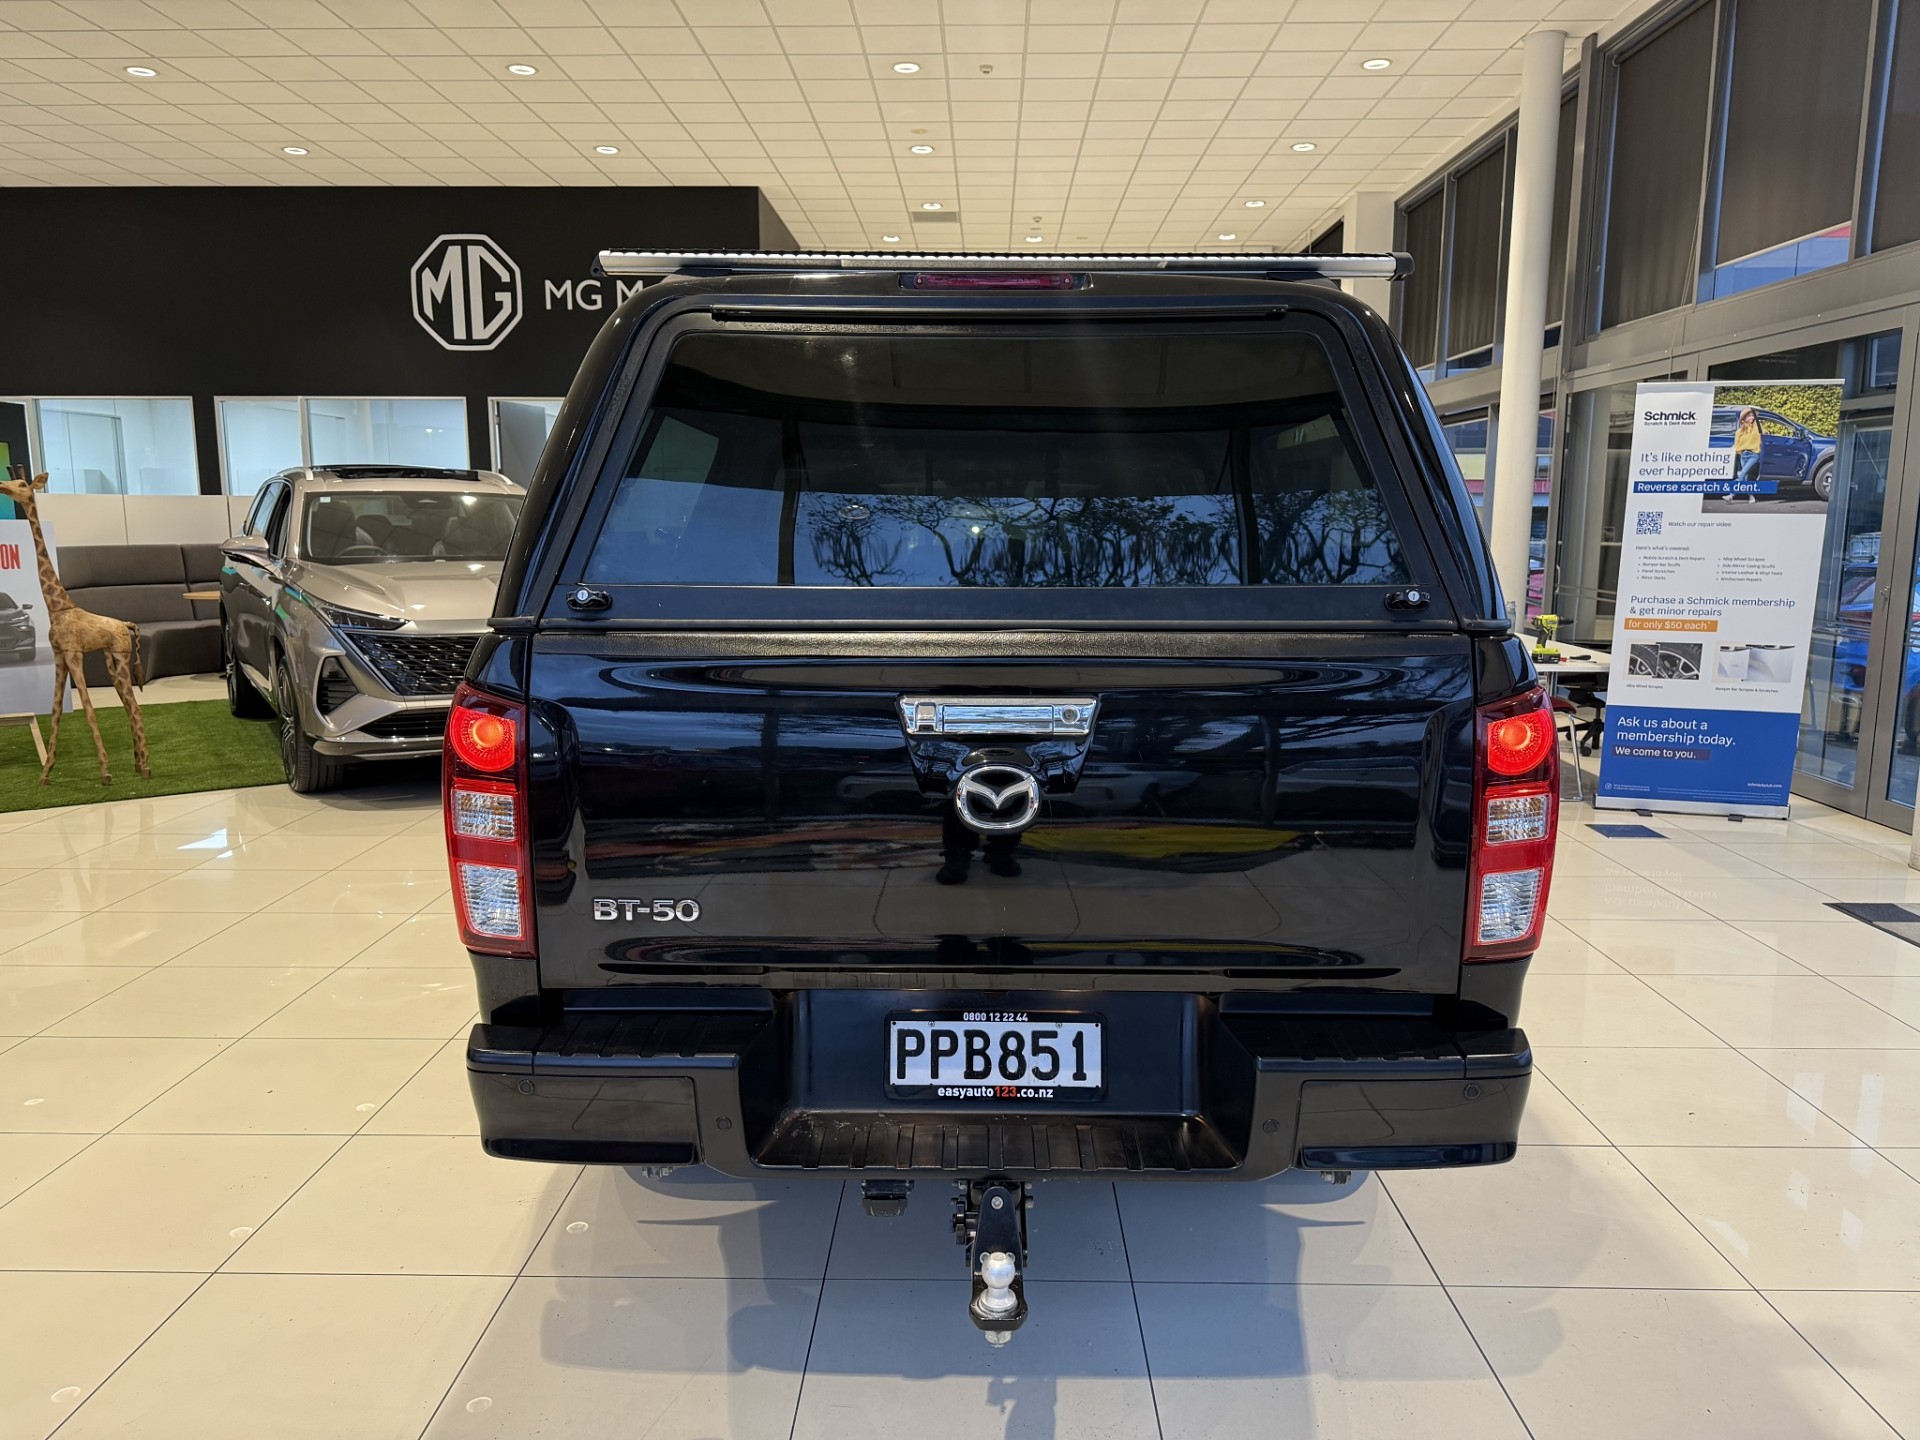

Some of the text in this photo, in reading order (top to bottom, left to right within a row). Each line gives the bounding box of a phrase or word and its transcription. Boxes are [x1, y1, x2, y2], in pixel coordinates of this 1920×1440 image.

[421, 245, 512, 340] MG
[544, 279, 603, 311] MG
[1643, 410, 1697, 421] Schmick
[1641, 452, 1730, 464] It's like nothing
[1639, 466, 1729, 478] ever happened.
[1637, 482, 1761, 492] Reverse scratch & dent.
[1630, 595, 1796, 609] Purchase a Schmick membership
[1629, 606, 1722, 617] & get minor repairs
[1628, 620, 1642, 628] for
[1643, 620, 1663, 630] only
[1664, 621, 1682, 629] $50
[1617, 716, 1708, 730] Ask us about a
[1616, 731, 1736, 747] membership today.
[1615, 746, 1696, 759] We come to you.
[593, 898, 700, 922] BT-50
[963, 1012, 1028, 1021] 0800 12 22 44
[896, 1028, 1087, 1082] PPB851
[937, 1086, 1054, 1099] easyauto123.co.nz
